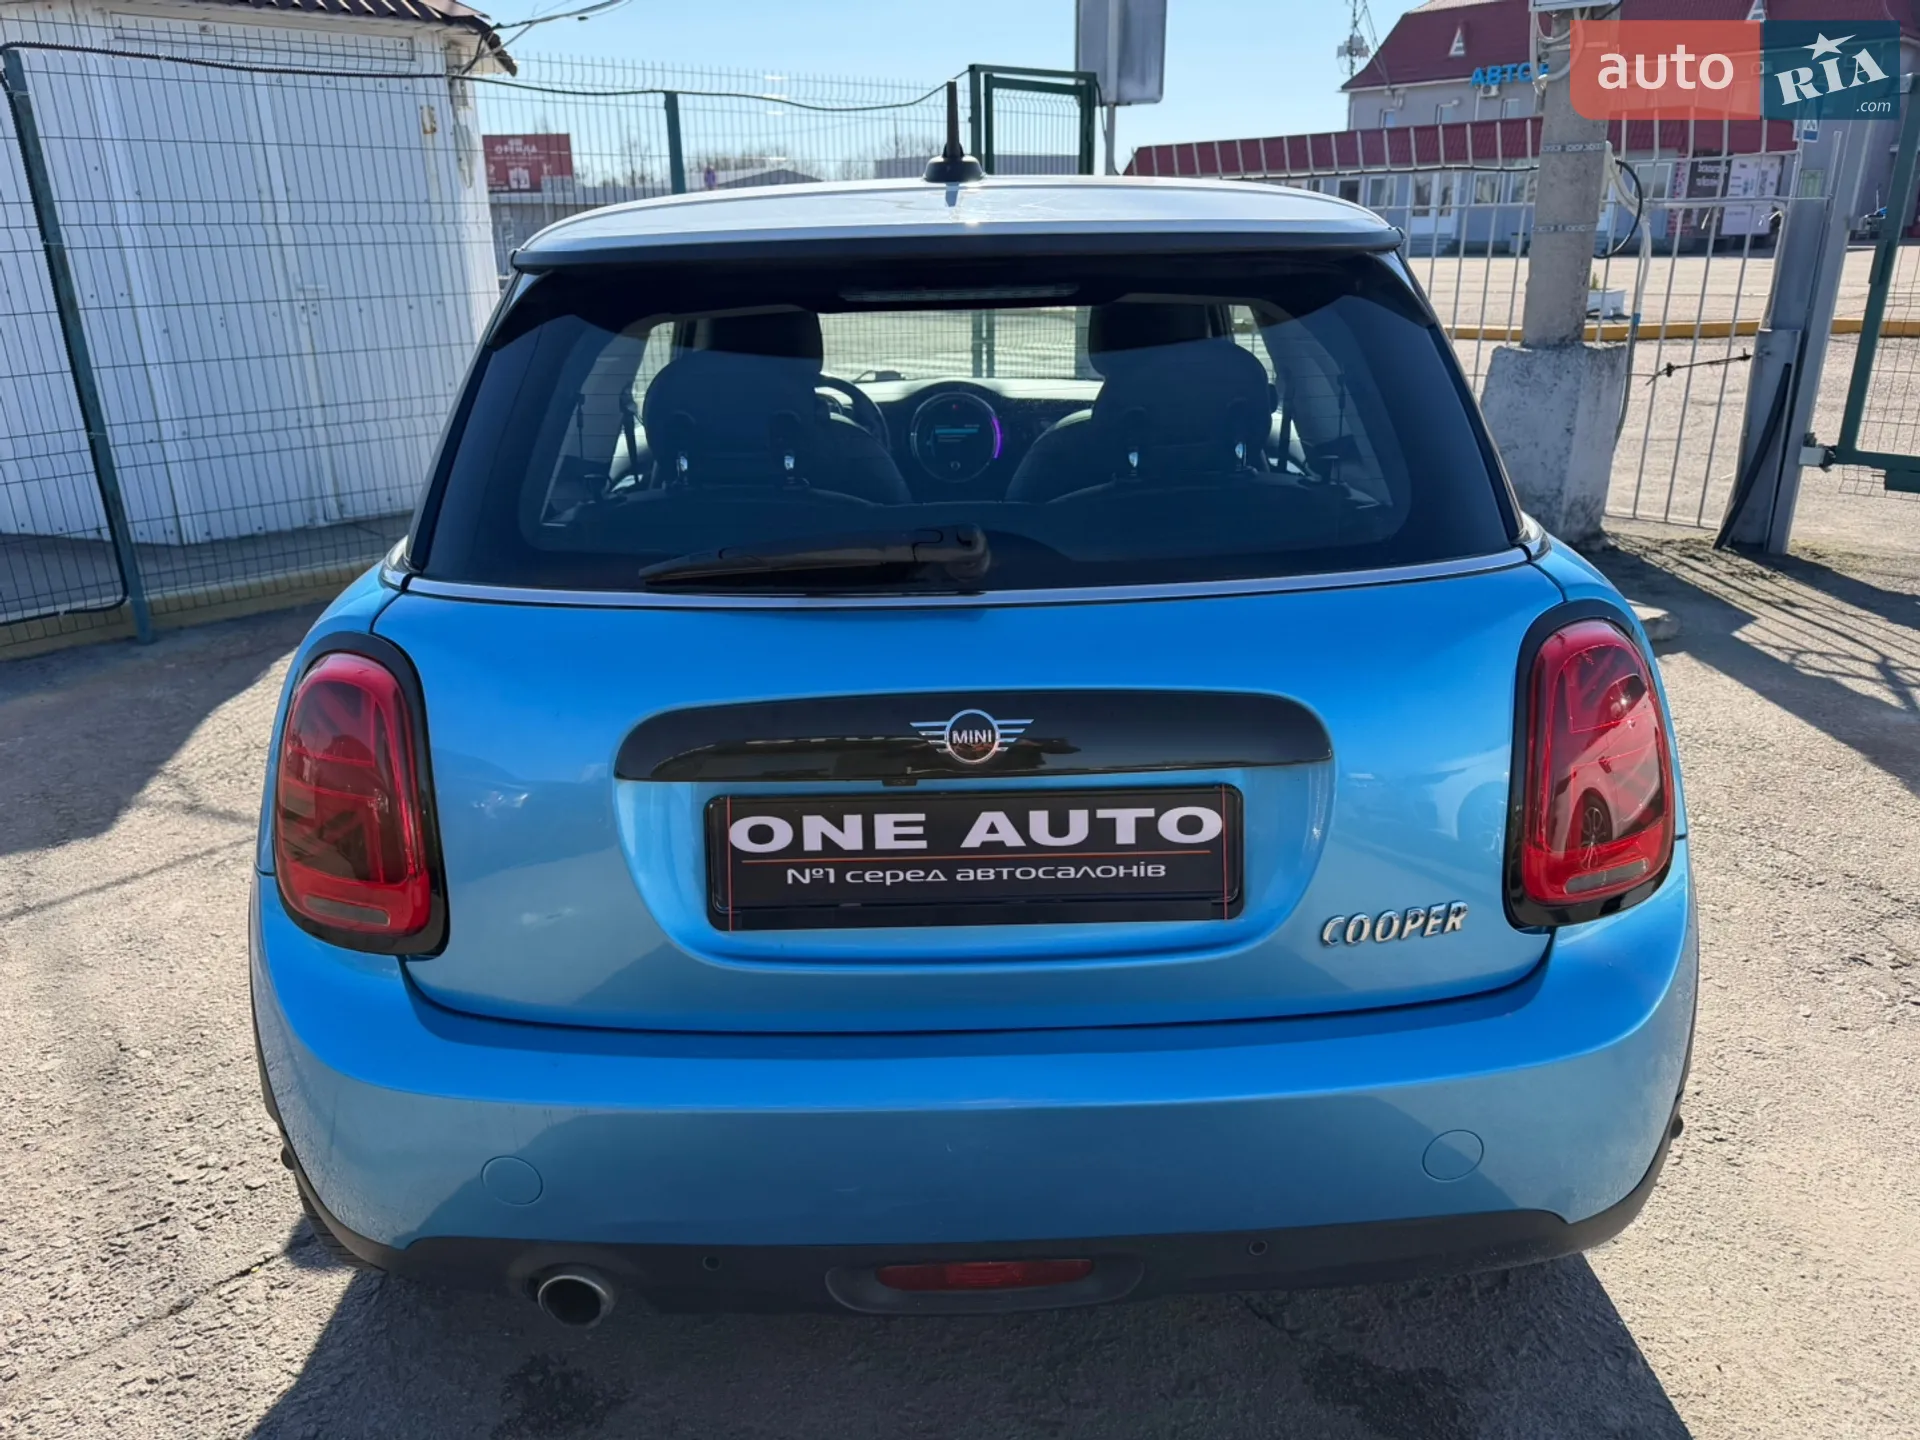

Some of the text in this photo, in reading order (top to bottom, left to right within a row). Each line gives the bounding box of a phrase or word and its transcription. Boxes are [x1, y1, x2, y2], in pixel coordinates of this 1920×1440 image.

[951, 729, 992, 744] MINI
[729, 806, 1224, 853] ONE AUTO
[845, 868, 948, 886] серед
[955, 861, 1166, 882] автосалонів
[1321, 900, 1469, 946] COOPER
